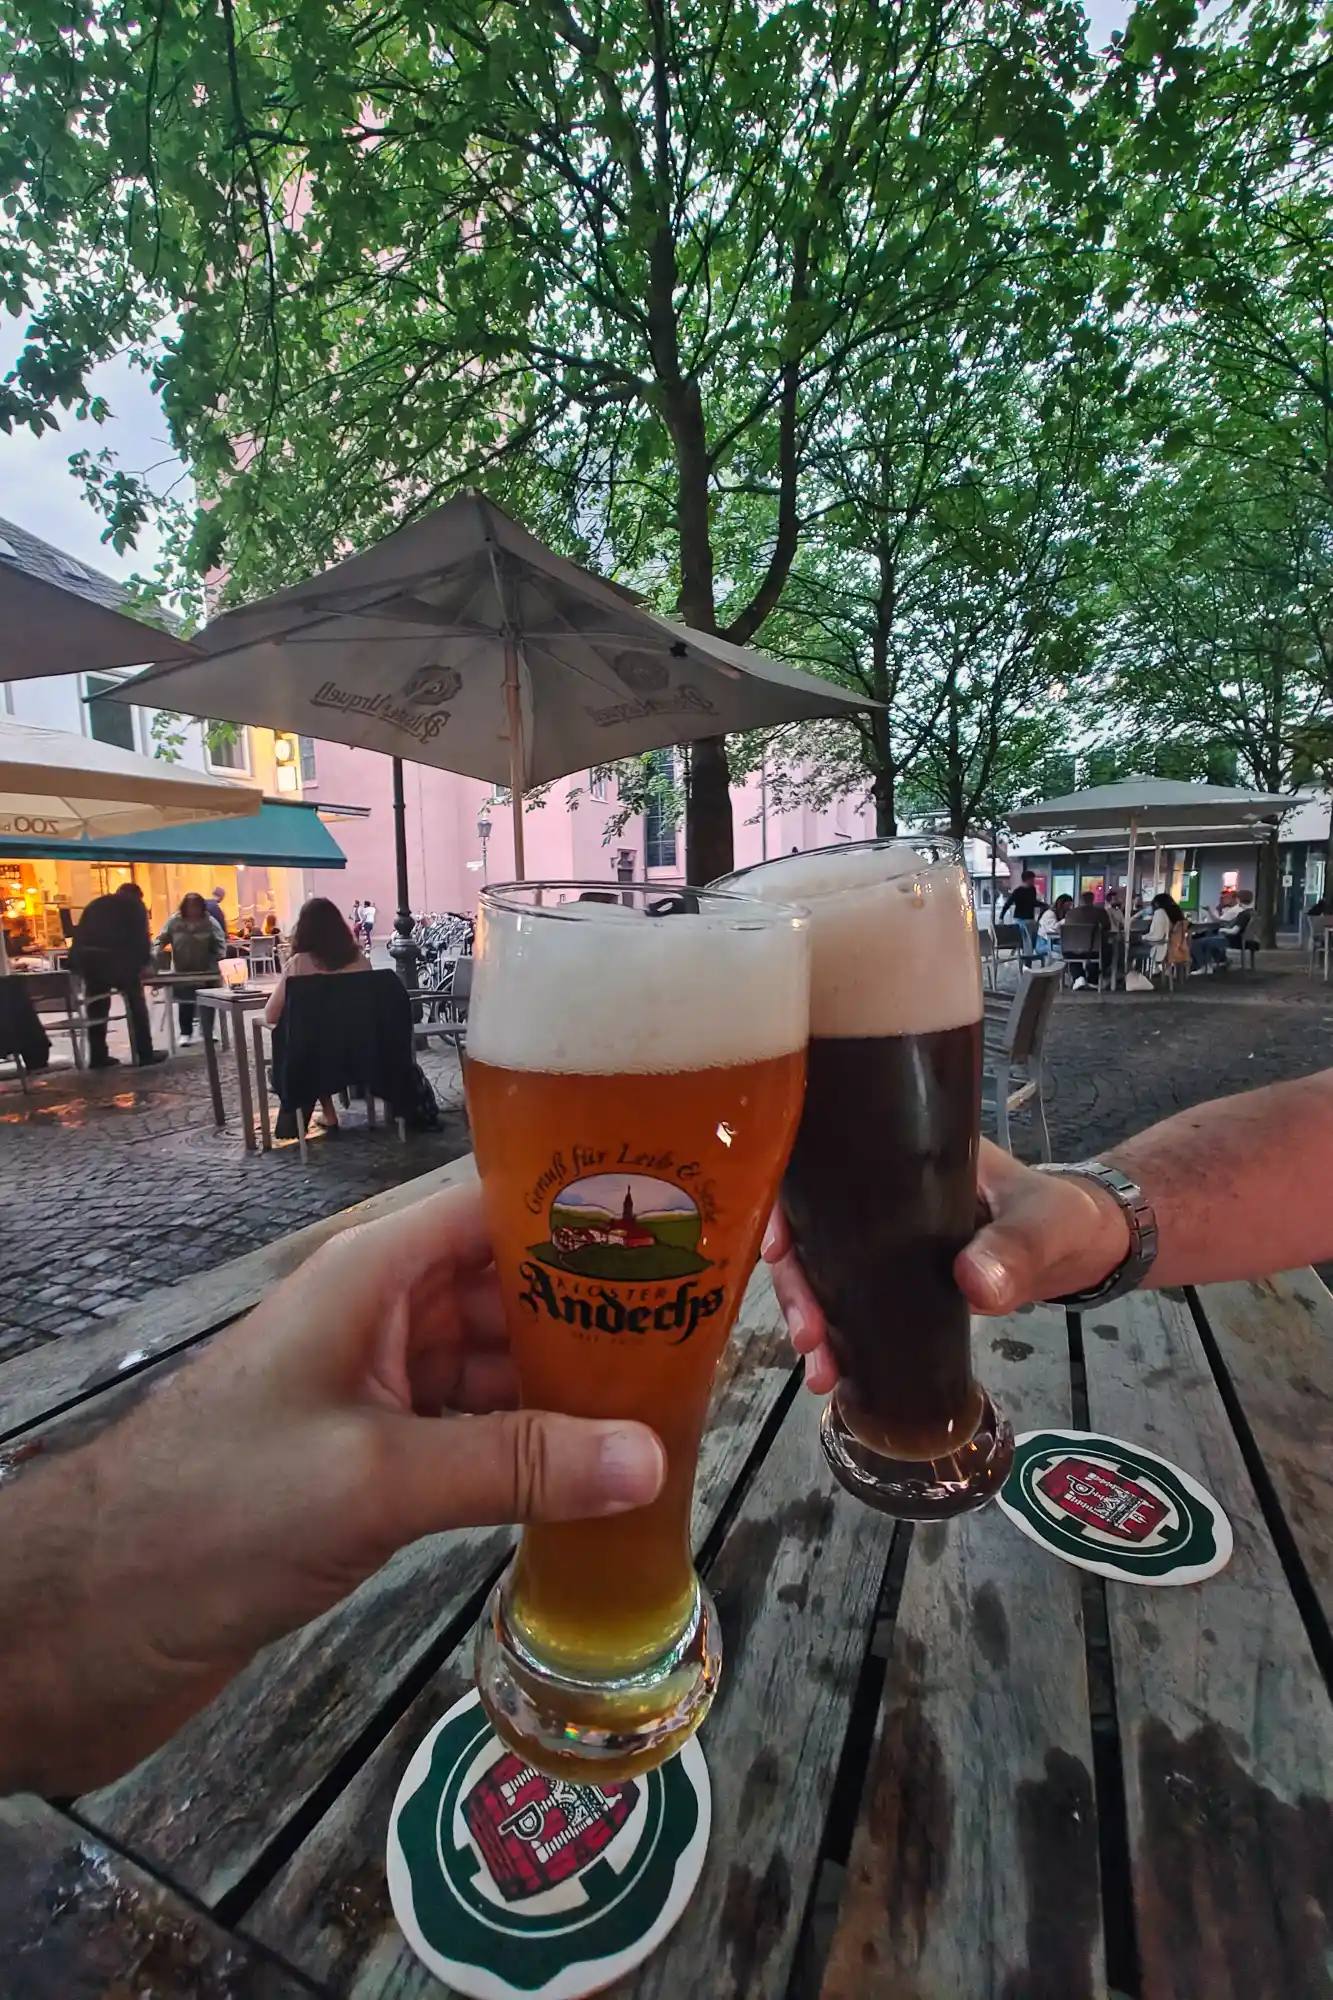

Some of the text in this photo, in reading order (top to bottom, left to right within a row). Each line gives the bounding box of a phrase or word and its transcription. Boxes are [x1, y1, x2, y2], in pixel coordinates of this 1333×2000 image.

[571, 1142, 607, 1175] für
[676, 1160, 700, 1181] &
[518, 1261, 725, 1345] Andechs
